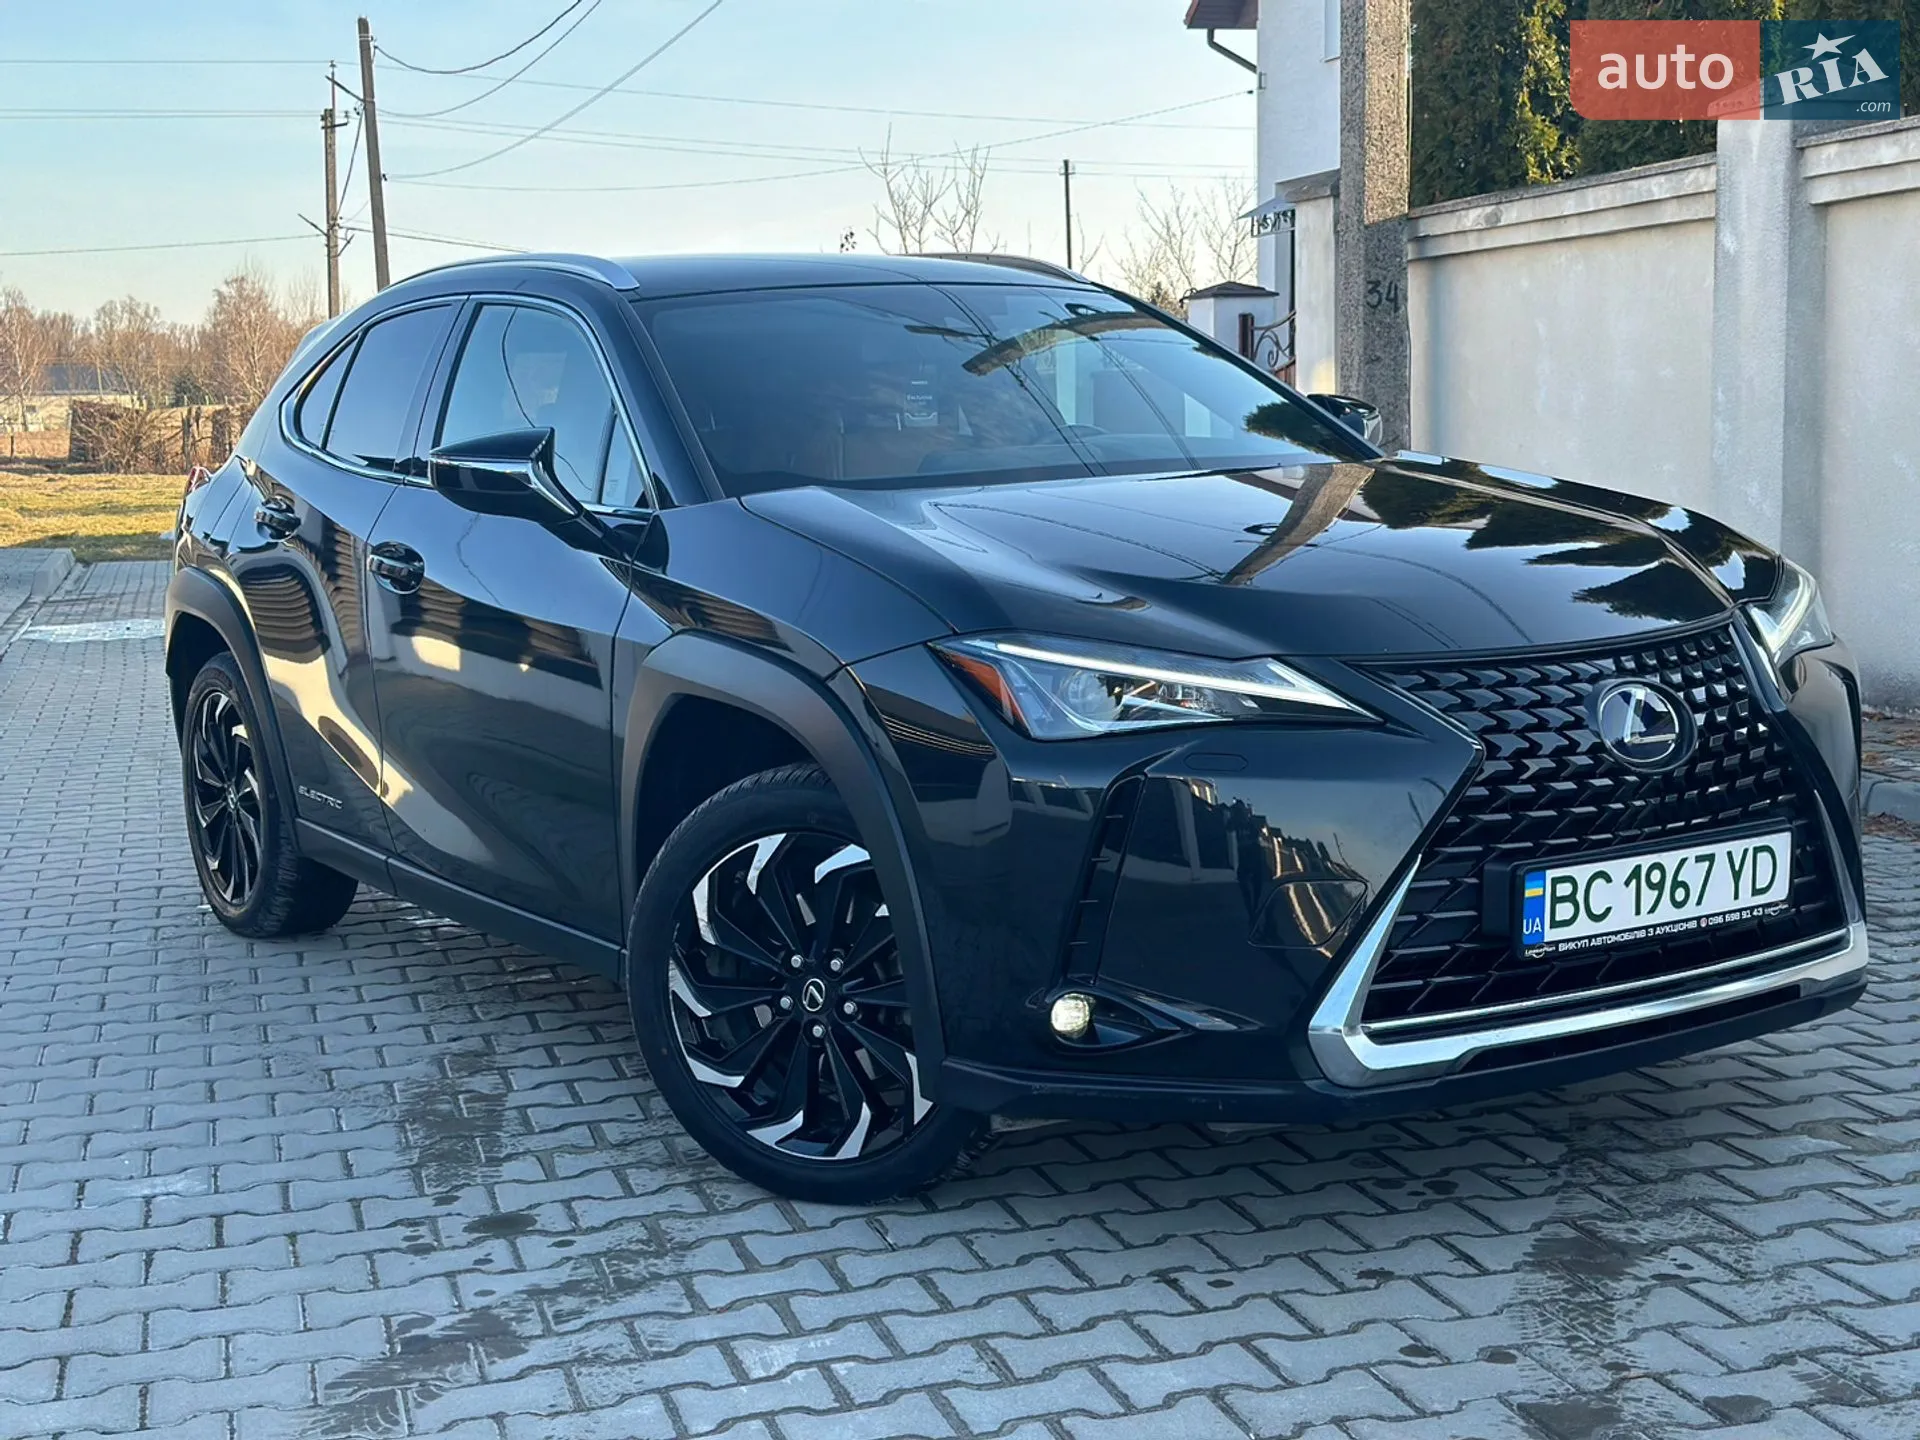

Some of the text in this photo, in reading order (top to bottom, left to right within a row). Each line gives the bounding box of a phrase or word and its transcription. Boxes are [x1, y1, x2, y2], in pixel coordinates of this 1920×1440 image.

[1366, 279, 1399, 313] 34
[1549, 844, 1778, 929] BC 1967 YD
[1522, 916, 1543, 935] UA
[1558, 939, 1589, 952] ВИКУП
